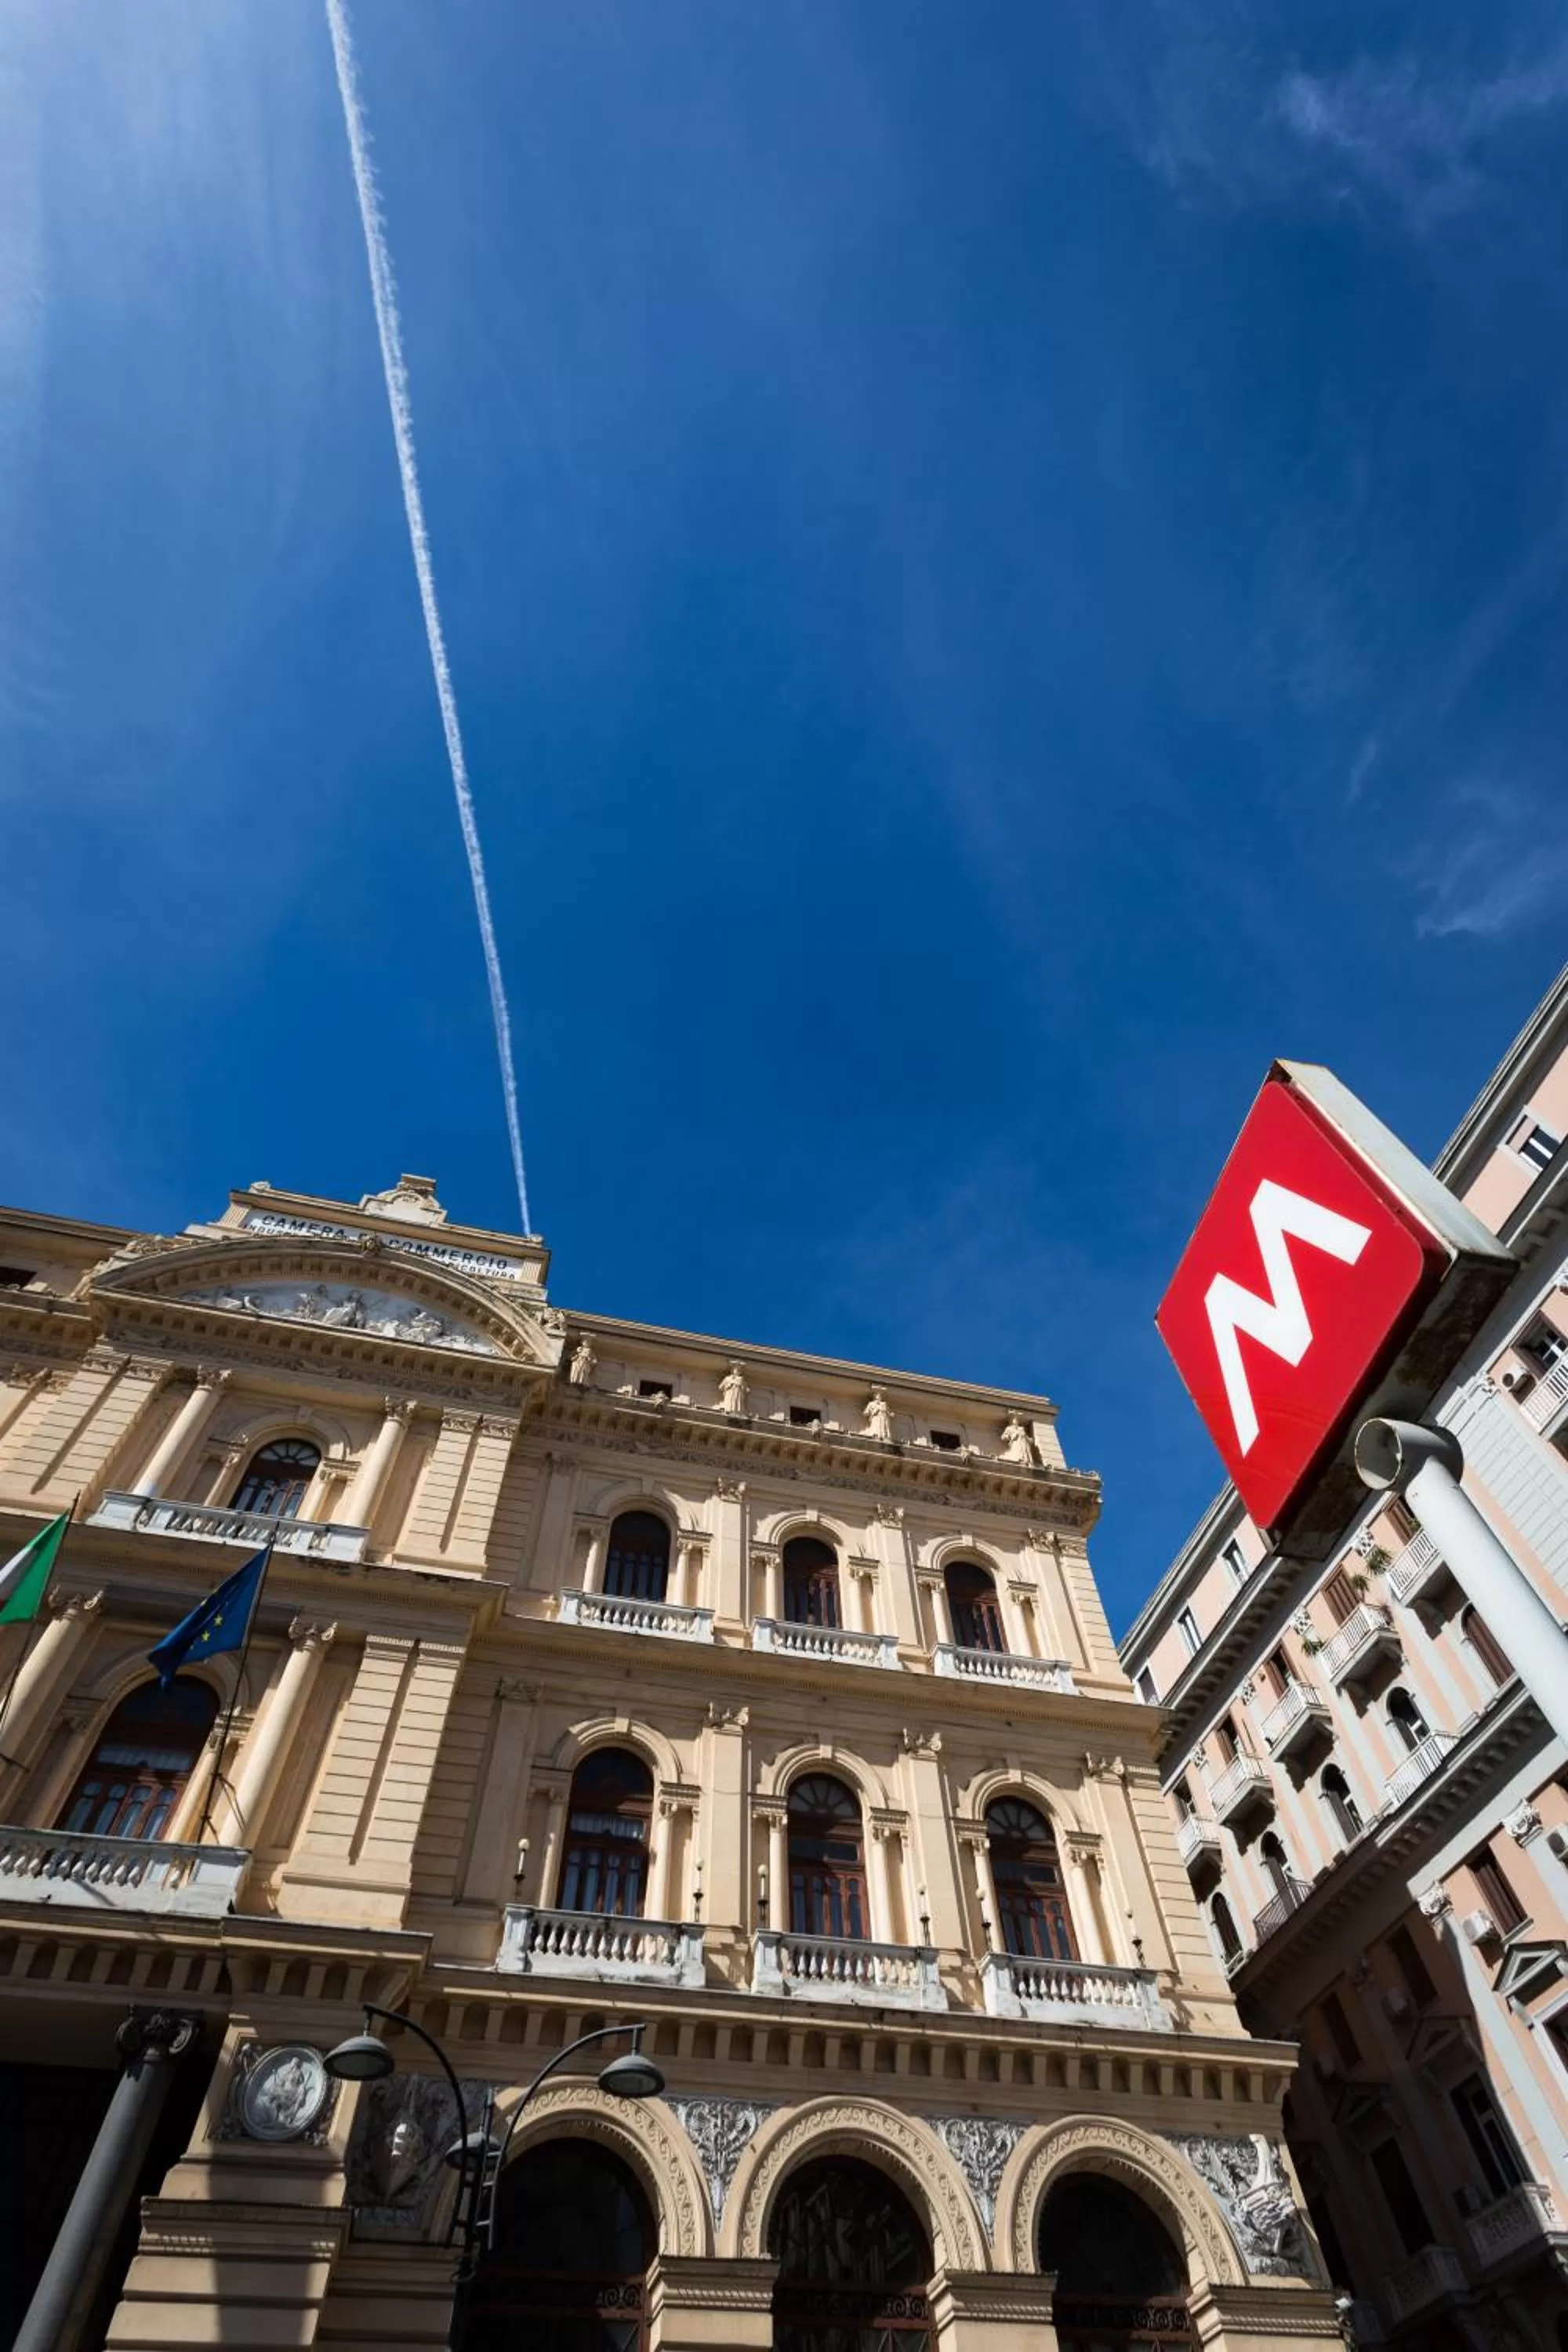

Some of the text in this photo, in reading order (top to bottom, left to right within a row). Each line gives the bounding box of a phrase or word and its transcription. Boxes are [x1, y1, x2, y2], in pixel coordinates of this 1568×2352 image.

[261, 1214, 345, 1237] CAMERA
[388, 1239, 508, 1269] COMMERCIO
[1204, 1178, 1372, 1457] M
